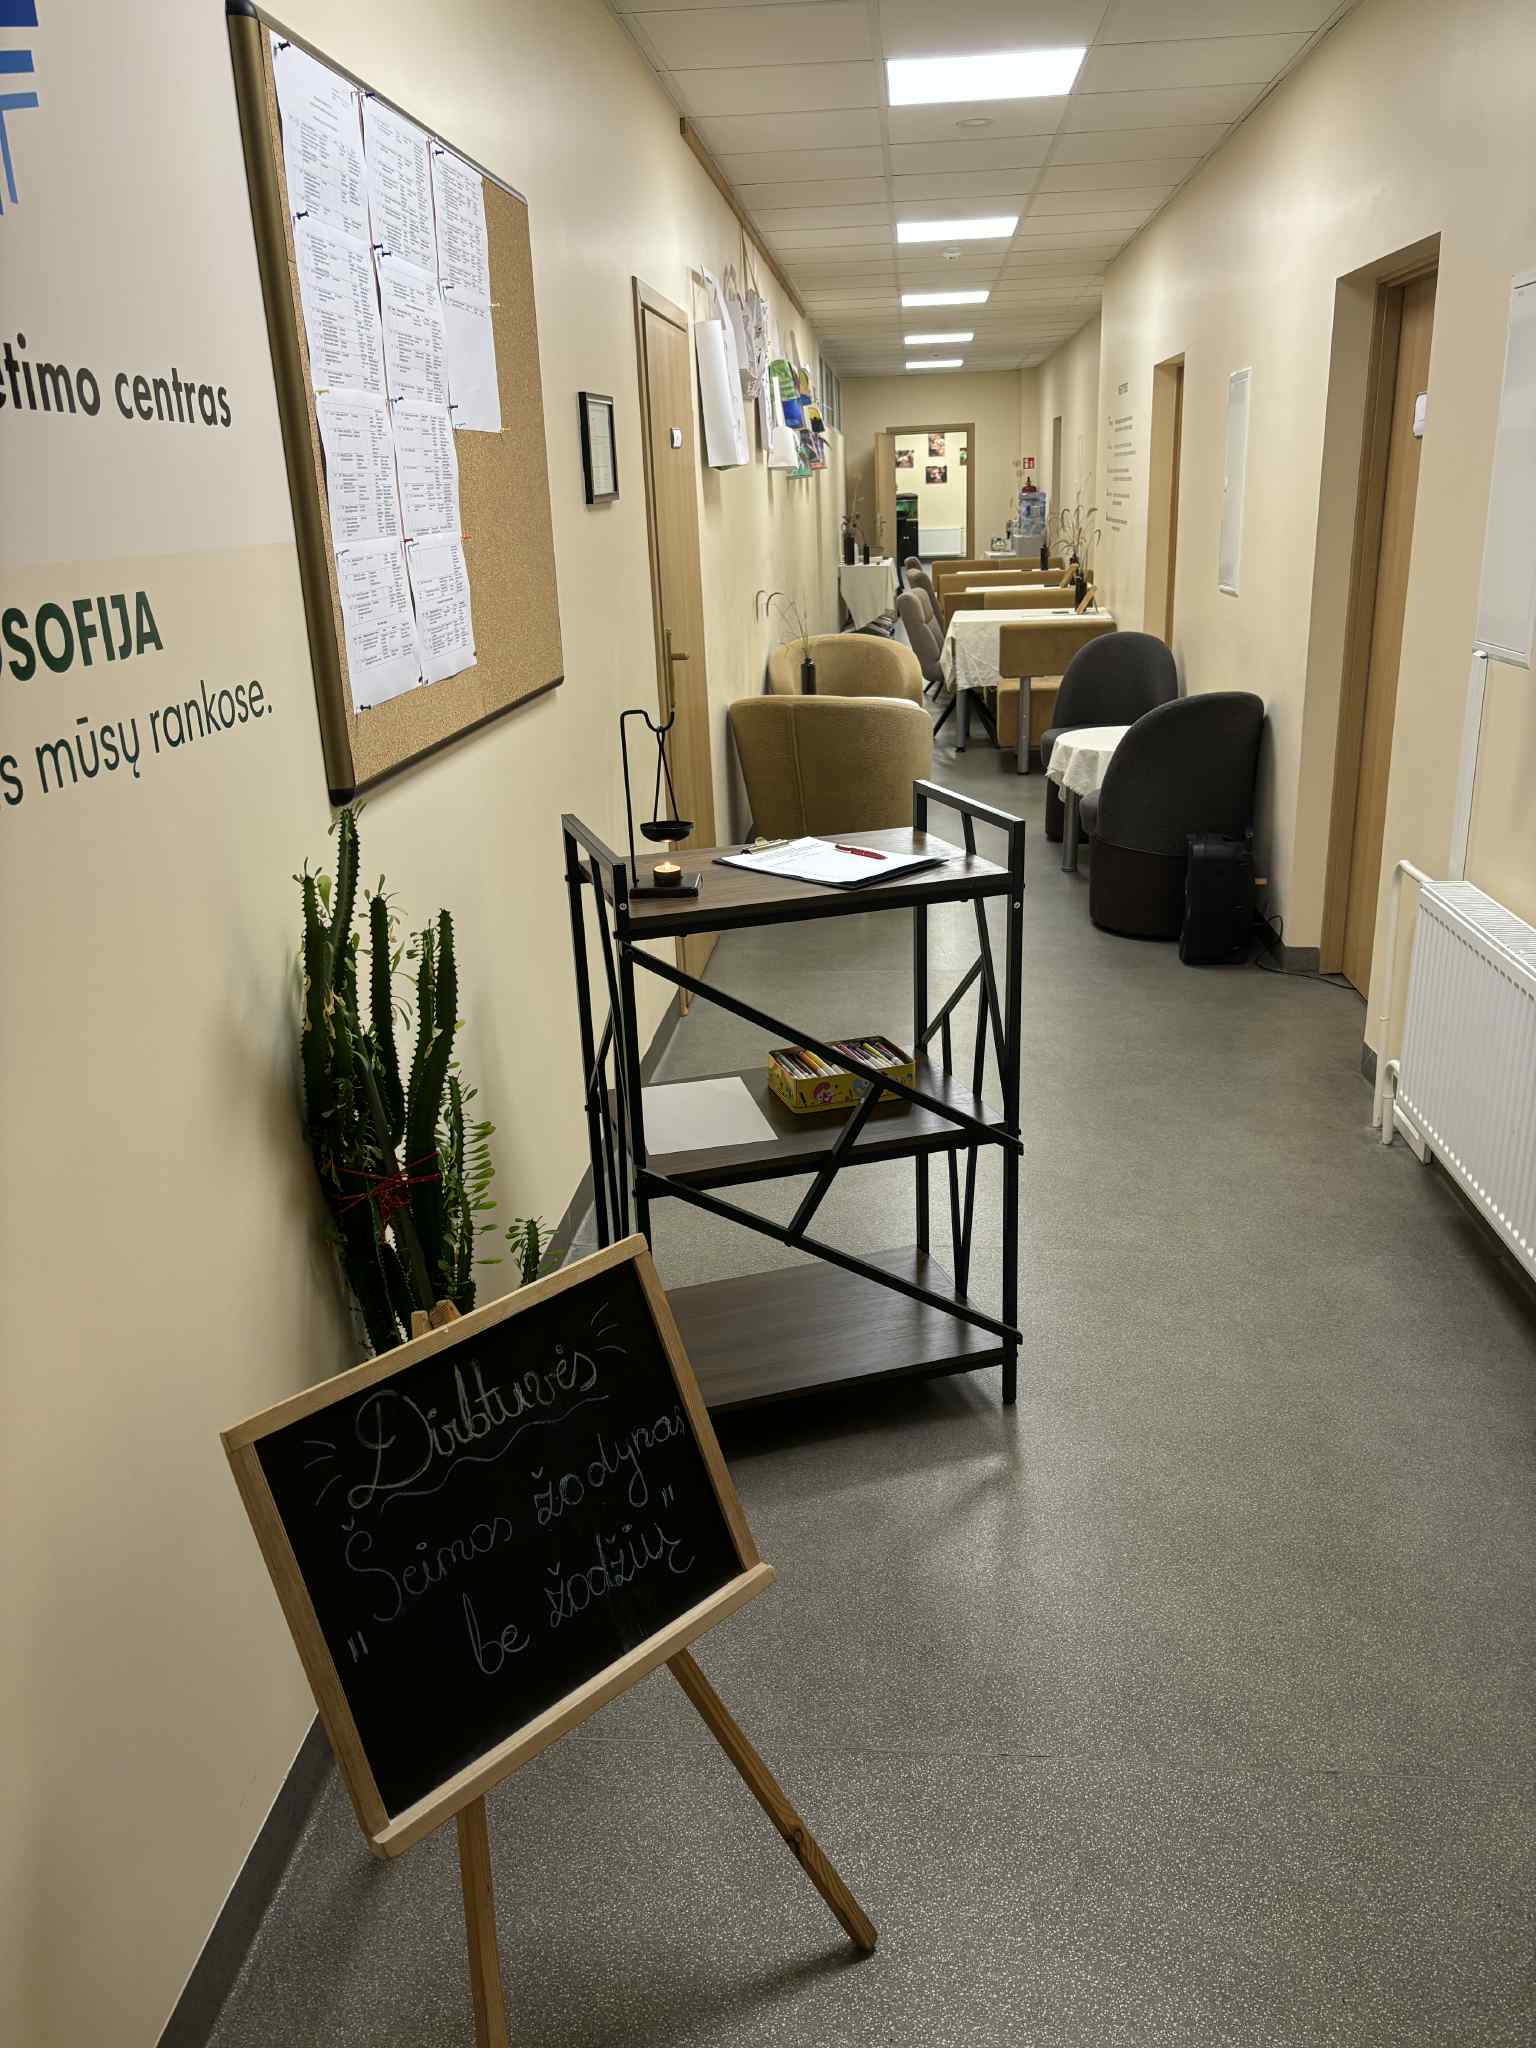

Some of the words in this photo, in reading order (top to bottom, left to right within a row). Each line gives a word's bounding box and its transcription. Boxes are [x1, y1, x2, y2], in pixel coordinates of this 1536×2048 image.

[115, 367, 232, 428] centras
[0, 590, 163, 682] SOFIJA
[36, 716, 140, 794] mūsų
[150, 678, 272, 754] rankose.
[347, 1343, 598, 1510] Dirbtuvės
[532, 1404, 687, 1527] žodynas
[462, 1591, 530, 1675] be
